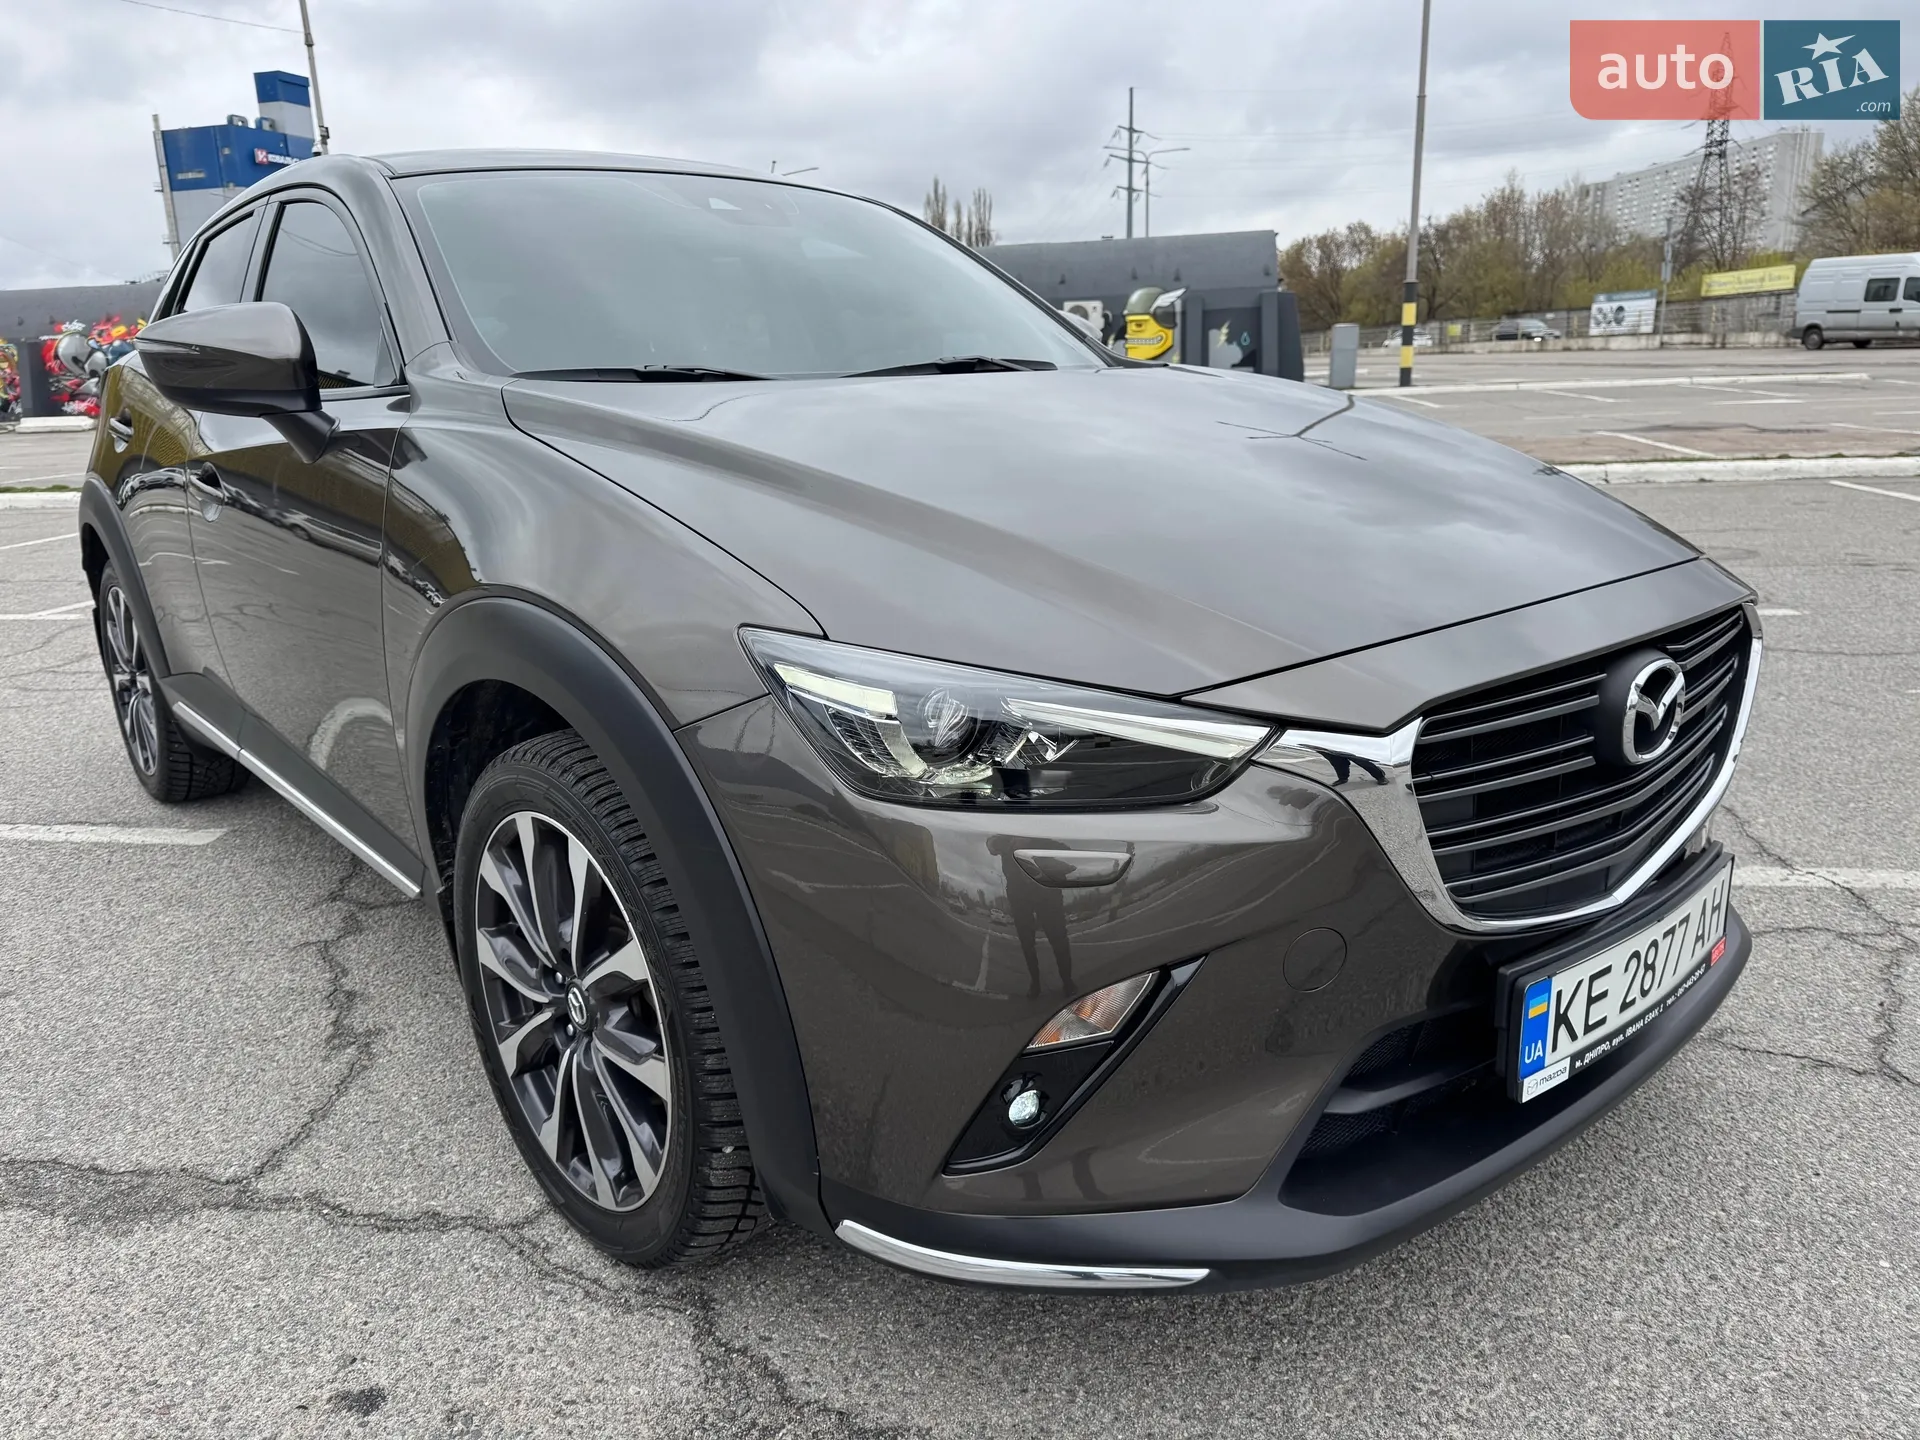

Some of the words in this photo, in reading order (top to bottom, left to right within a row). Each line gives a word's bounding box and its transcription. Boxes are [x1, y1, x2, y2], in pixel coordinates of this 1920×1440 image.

[1551, 963, 1613, 1054] KE
[1618, 911, 1691, 1015] 2877
[1691, 879, 1725, 960] AH
[1524, 1039, 1543, 1064] UA
